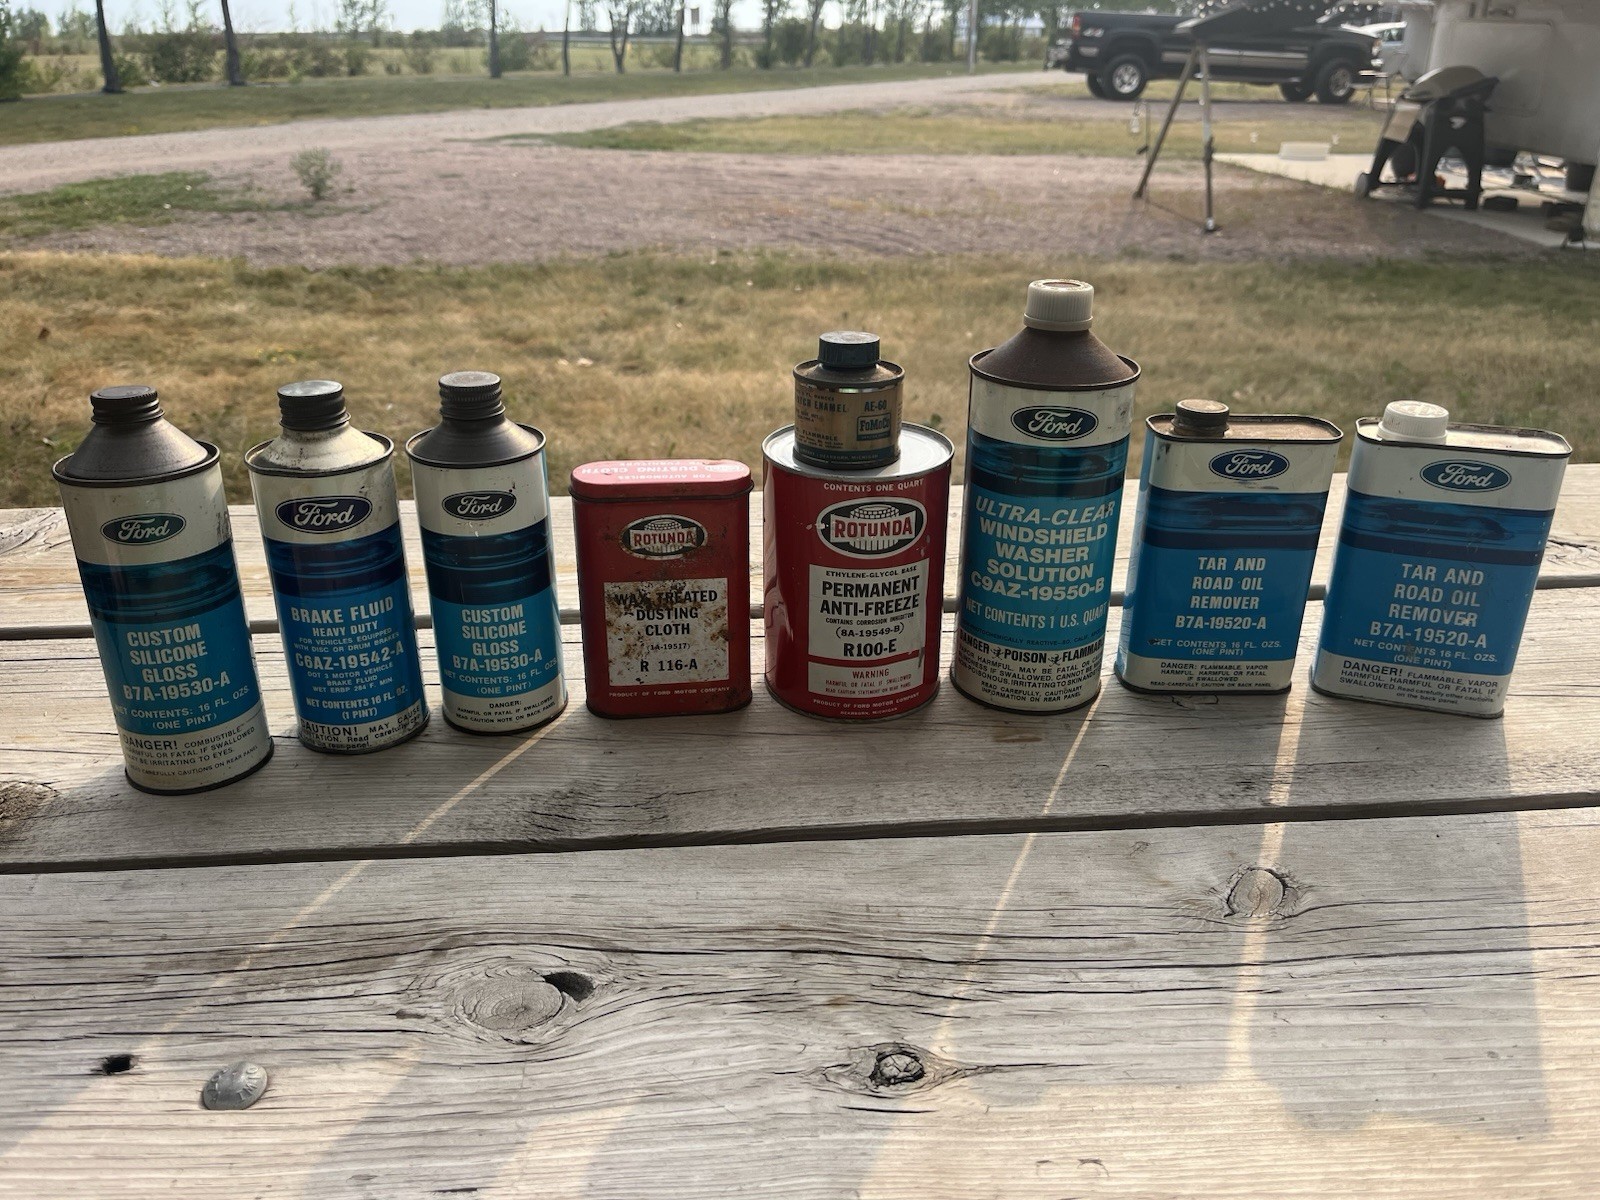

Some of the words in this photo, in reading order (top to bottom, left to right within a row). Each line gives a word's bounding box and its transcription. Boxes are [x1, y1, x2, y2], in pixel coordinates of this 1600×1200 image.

[815, 400, 847, 413] ENAMEL
[1028, 410, 1083, 434] Ford
[582, 466, 628, 474] CLOTH
[1224, 453, 1274, 475] Ford
[1438, 463, 1494, 488] Ford
[823, 482, 872, 492] CONTENTS
[876, 484, 894, 492] ONE
[898, 478, 924, 490] QUART
[294, 501, 355, 526] Ford
[457, 496, 502, 514] Ford
[976, 496, 1116, 526] ULTRA-CLEAR
[118, 518, 170, 540] Ford
[834, 516, 914, 538] ROTUNDA
[980, 516, 1108, 544] WINDSHIELD
[633, 530, 696, 547] ROTUNDA
[996, 541, 1090, 564] WASHER
[826, 570, 898, 578] ETHYLENE-GLYCOL
[902, 565, 918, 574] BASE
[986, 558, 1094, 582] SOLUTION
[1198, 557, 1227, 571] TAR
[1234, 558, 1266, 572] AND
[1192, 576, 1234, 590] ROAD
[1241, 578, 1264, 590] OIL
[1402, 564, 1437, 582] TAR
[1444, 568, 1484, 587] AND
[822, 575, 920, 598] PERMANENT
[970, 570, 1104, 601] C9AZ-19550-B
[656, 590, 718, 604] TREATED
[820, 594, 920, 616] ANTI-FREEZE
[1190, 596, 1260, 610] REMOVER
[1394, 584, 1444, 603] ROAD
[1451, 590, 1481, 608] OIL
[290, 606, 344, 624] BRAKE
[350, 596, 394, 621] FLUID
[462, 604, 524, 624] CUSTOM
[636, 606, 698, 621] DUSTING
[966, 597, 982, 616] NET
[984, 606, 1046, 629] CONTENTS
[1050, 616, 1055, 628] 1
[1060, 614, 1079, 628] U.S.
[1083, 601, 1108, 626] QUART
[1388, 603, 1478, 628] REMOVER
[312, 627, 346, 638] HEAVY
[350, 620, 378, 635] DUTY
[462, 620, 526, 640] SILICONE
[645, 622, 690, 636] CLOTH
[826, 618, 854, 626] CONTAINS
[835, 622, 905, 639] (8A-19549-B)
[1175, 615, 1267, 630] B7A-19520-A
[127, 623, 202, 647] CUSTOM
[300, 637, 312, 645] FOR
[316, 638, 353, 646] VEHICLES
[356, 628, 392, 642] EQUIPPED
[348, 642, 371, 652] DRUM
[374, 632, 400, 646] BRAKES
[1370, 621, 1488, 649] B7A-19520-A
[130, 641, 208, 666] SILICONE
[472, 640, 519, 656] GLOSS
[1176, 640, 1227, 649] CONTENTS
[1354, 638, 1375, 648] NET
[1378, 642, 1436, 656] CONTENTS
[1440, 650, 1452, 658] 16
[1474, 653, 1498, 663] OZS.
[295, 640, 404, 670] C6AZ-19542-A
[452, 648, 542, 672] B7A-19530-A
[1004, 648, 1047, 664] POISON
[1394, 654, 1420, 664] (ONE
[1424, 658, 1452, 670] PINT)
[142, 663, 198, 684] GLOSS
[332, 671, 360, 679] MOTOR
[364, 661, 394, 674] VEHICLE
[640, 660, 649, 672] R
[658, 658, 698, 672] 116-A
[852, 668, 890, 679] WARNING
[1056, 664, 1078, 672] FATAL
[1160, 662, 1197, 670] DANGER:
[1343, 660, 1403, 677] DANGER!
[1468, 680, 1498, 688] VAPOR
[356, 674, 378, 684] FLUID
[460, 674, 512, 684] CONTENTS:
[826, 680, 848, 688] HARMFUL
[1011, 680, 1056, 688] IRRITATING
[1067, 678, 1082, 686] SKIN
[1056, 669, 1084, 681] CANNOT
[122, 670, 231, 701] B7A-19530-A
[476, 686, 501, 694] (ONE
[506, 681, 532, 692] PINT)
[700, 686, 730, 694] COMPANY
[980, 681, 998, 690] READ
[1044, 686, 1082, 696] CAUTIONARY
[982, 687, 1026, 701] INFORMATION
[1390, 677, 1432, 688] HARMFUL
[1455, 686, 1482, 694] FATAL
[306, 698, 320, 708] NET
[322, 698, 370, 710] CONTENTS
[383, 690, 396, 702] FL.
[396, 686, 408, 696] OZ.
[489, 700, 522, 708] DANGER:
[524, 696, 554, 712] SWALLOWED
[813, 698, 840, 708] PRODUCT
[872, 700, 894, 708] MOTOR
[896, 692, 920, 704] COMPANY
[130, 707, 194, 719] CONTENTS:
[198, 703, 210, 712] 16
[215, 697, 230, 708] FL.
[352, 707, 378, 720] PINT)
[527, 710, 541, 718] BACK
[152, 720, 180, 730] (ONE
[186, 713, 217, 726] PINT)
[369, 722, 390, 733] MAY
[398, 705, 420, 724] CAUSE
[124, 734, 178, 750] DANGER!
[184, 726, 242, 748] COMBUSTIBLE
[170, 750, 197, 758] FATAL
[210, 726, 255, 750] SWALLOWED
[150, 758, 196, 766] IRRITATING
[212, 746, 233, 758] EYES
